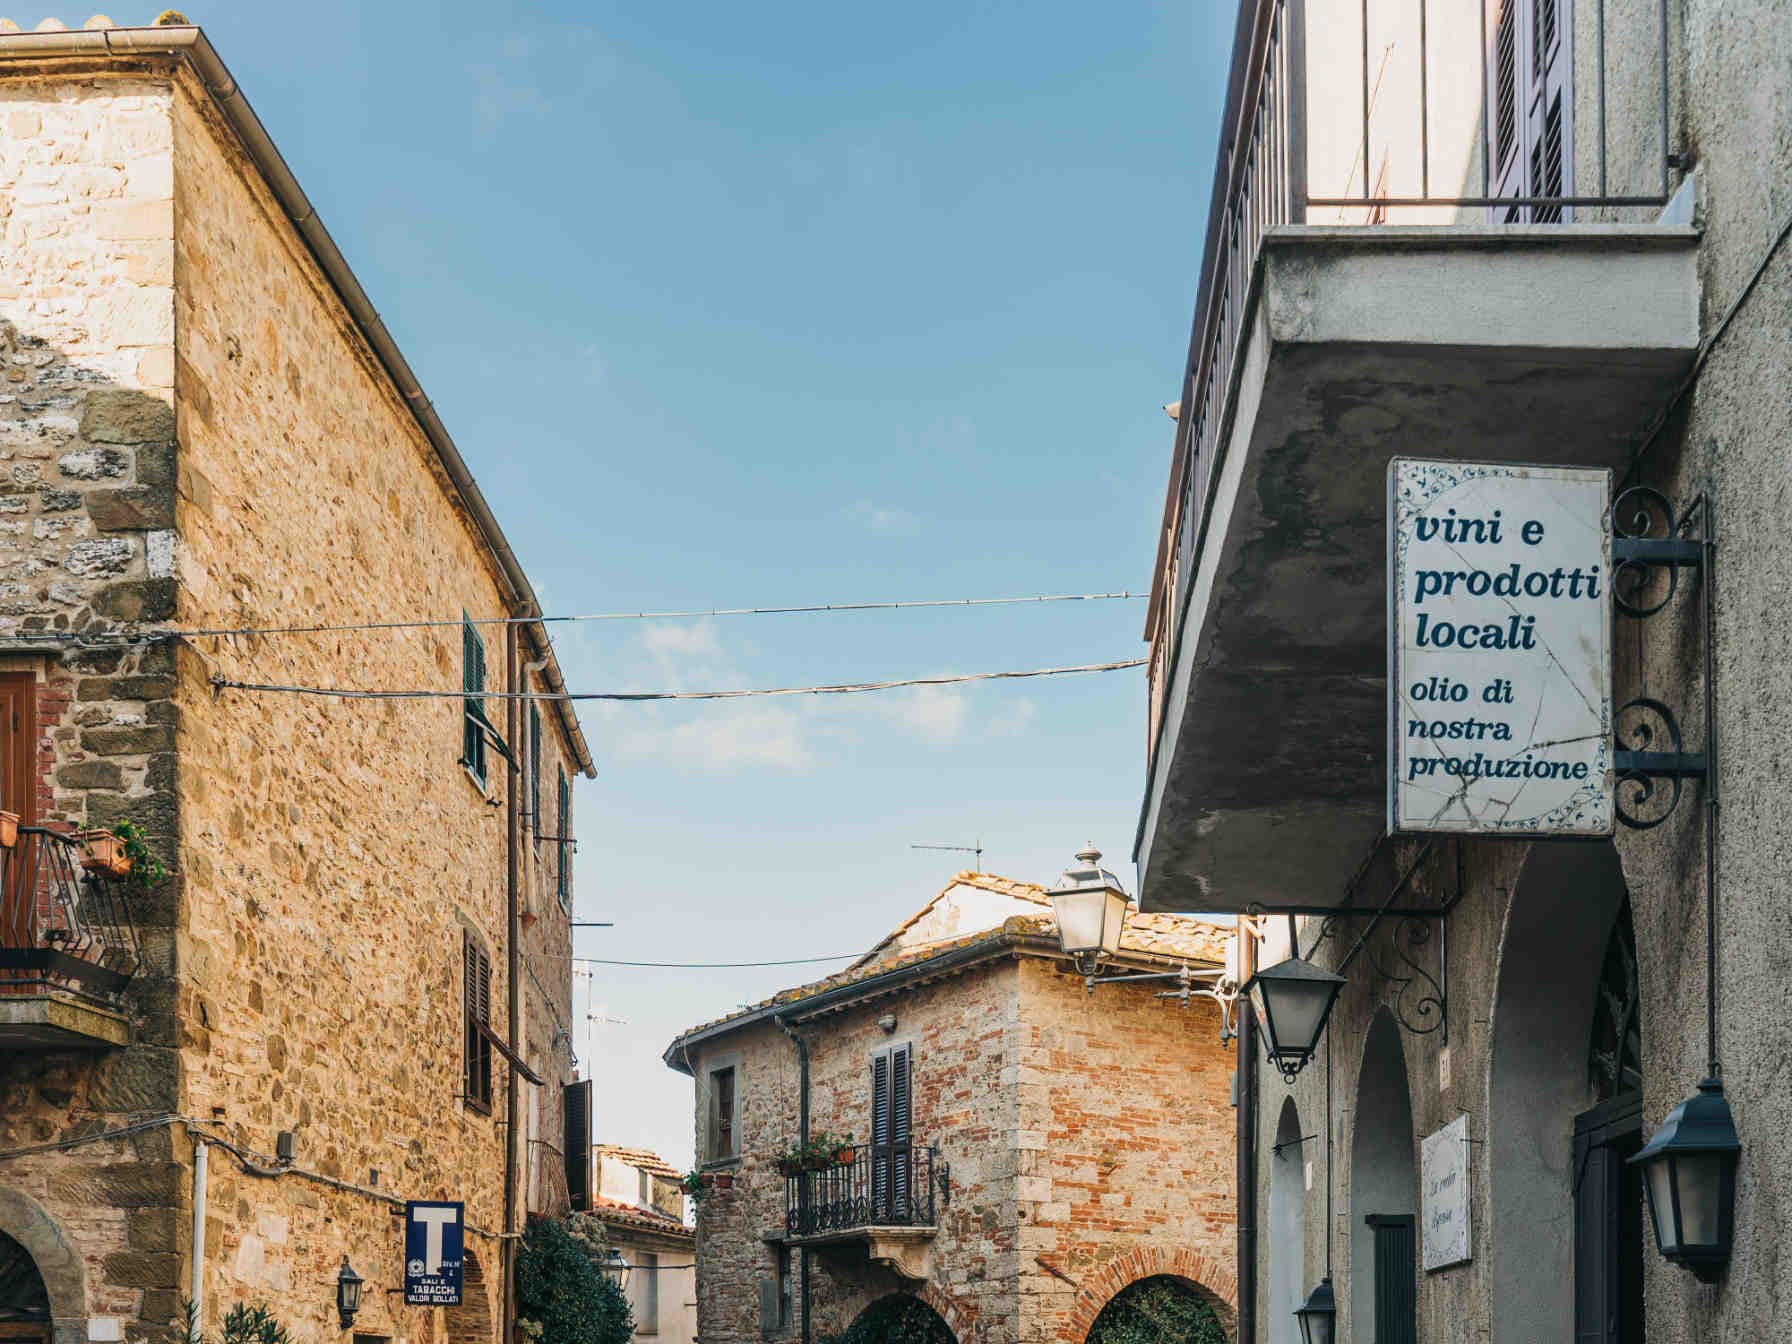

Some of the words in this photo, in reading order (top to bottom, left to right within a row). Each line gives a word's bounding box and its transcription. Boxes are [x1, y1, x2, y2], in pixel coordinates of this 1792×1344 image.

[1415, 508, 1503, 545] vini
[1520, 518, 1545, 546] e
[1413, 563, 1601, 604] prodotti
[1415, 612, 1537, 650] locali
[1409, 677, 1469, 703] olio
[1481, 678, 1514, 704] di
[1408, 715, 1513, 741] nostra
[1408, 752, 1589, 781] produzione
[413, 1206, 457, 1275] T
[412, 1285, 456, 1295] TABACCHI
